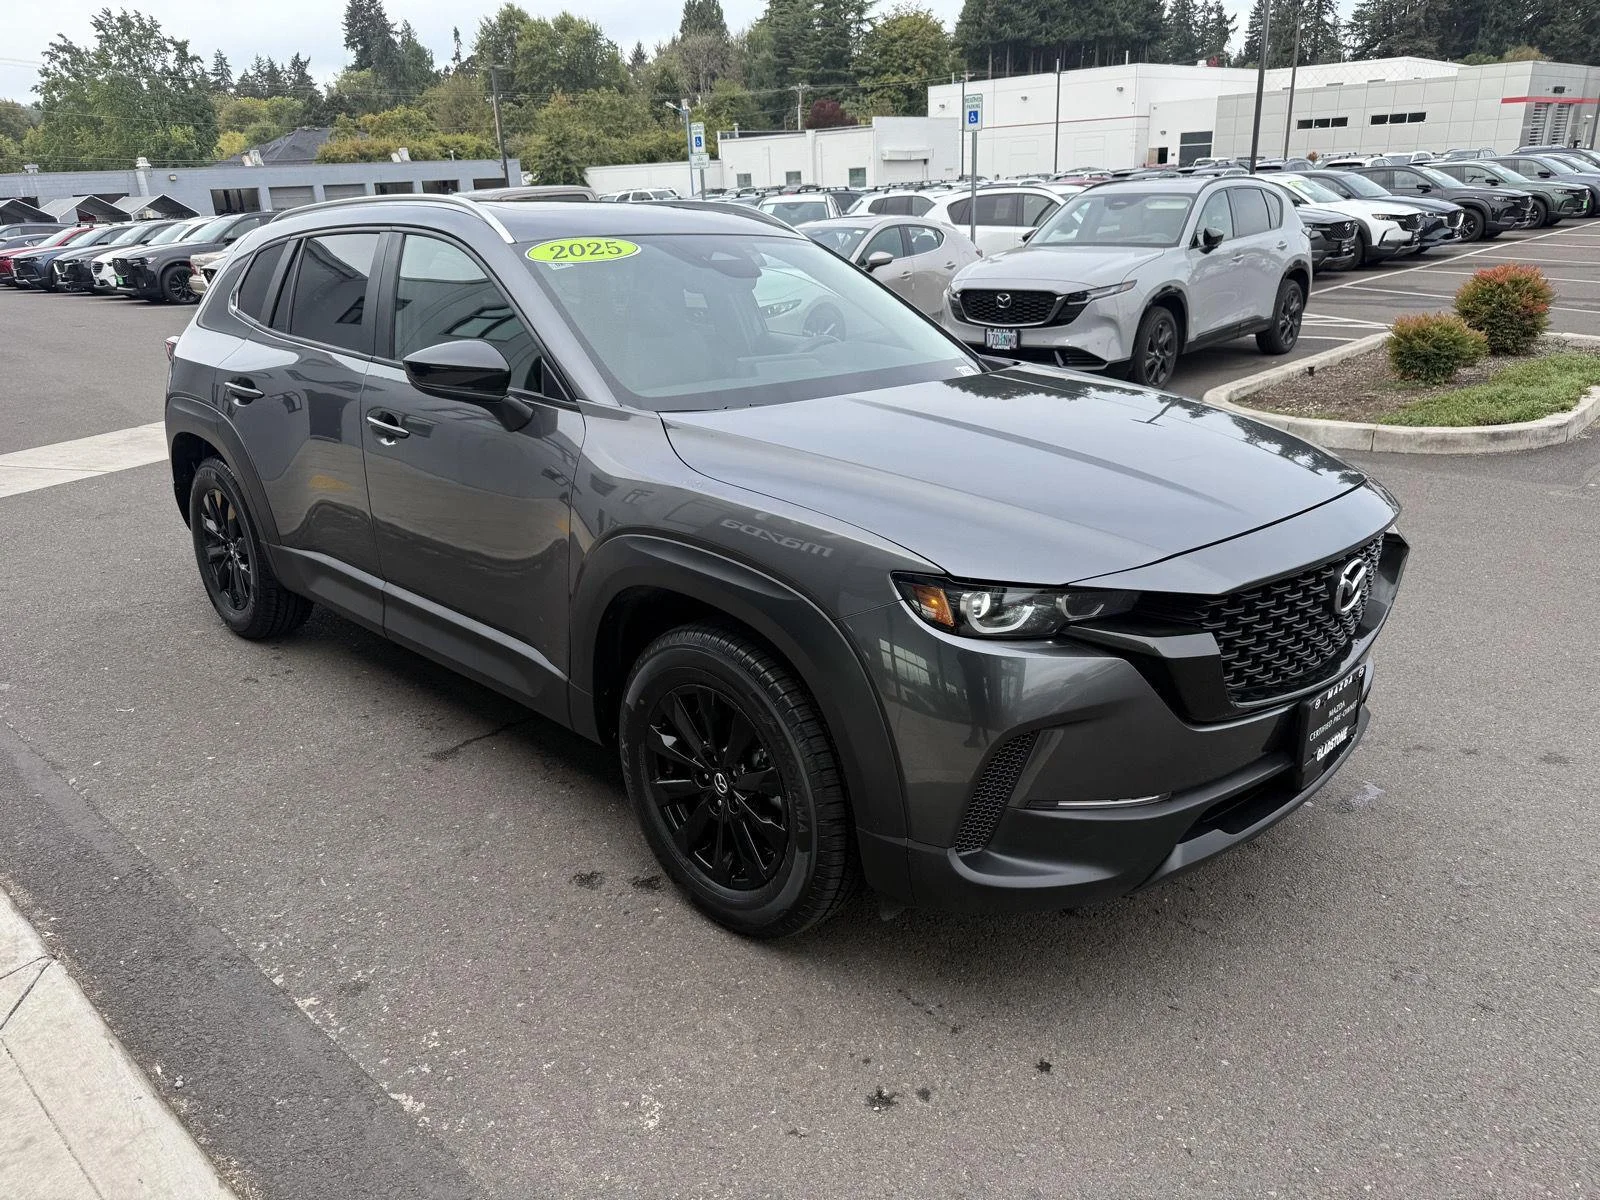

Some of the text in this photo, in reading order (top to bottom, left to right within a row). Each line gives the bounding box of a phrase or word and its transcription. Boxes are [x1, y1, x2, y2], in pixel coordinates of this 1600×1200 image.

[549, 241, 623, 260] 2025
[1327, 676, 1353, 700] MAZDA
[1328, 700, 1346, 718] MAZDA
[1309, 720, 1333, 741] CERTIFIED
[1316, 726, 1349, 762] GLADSTONE
